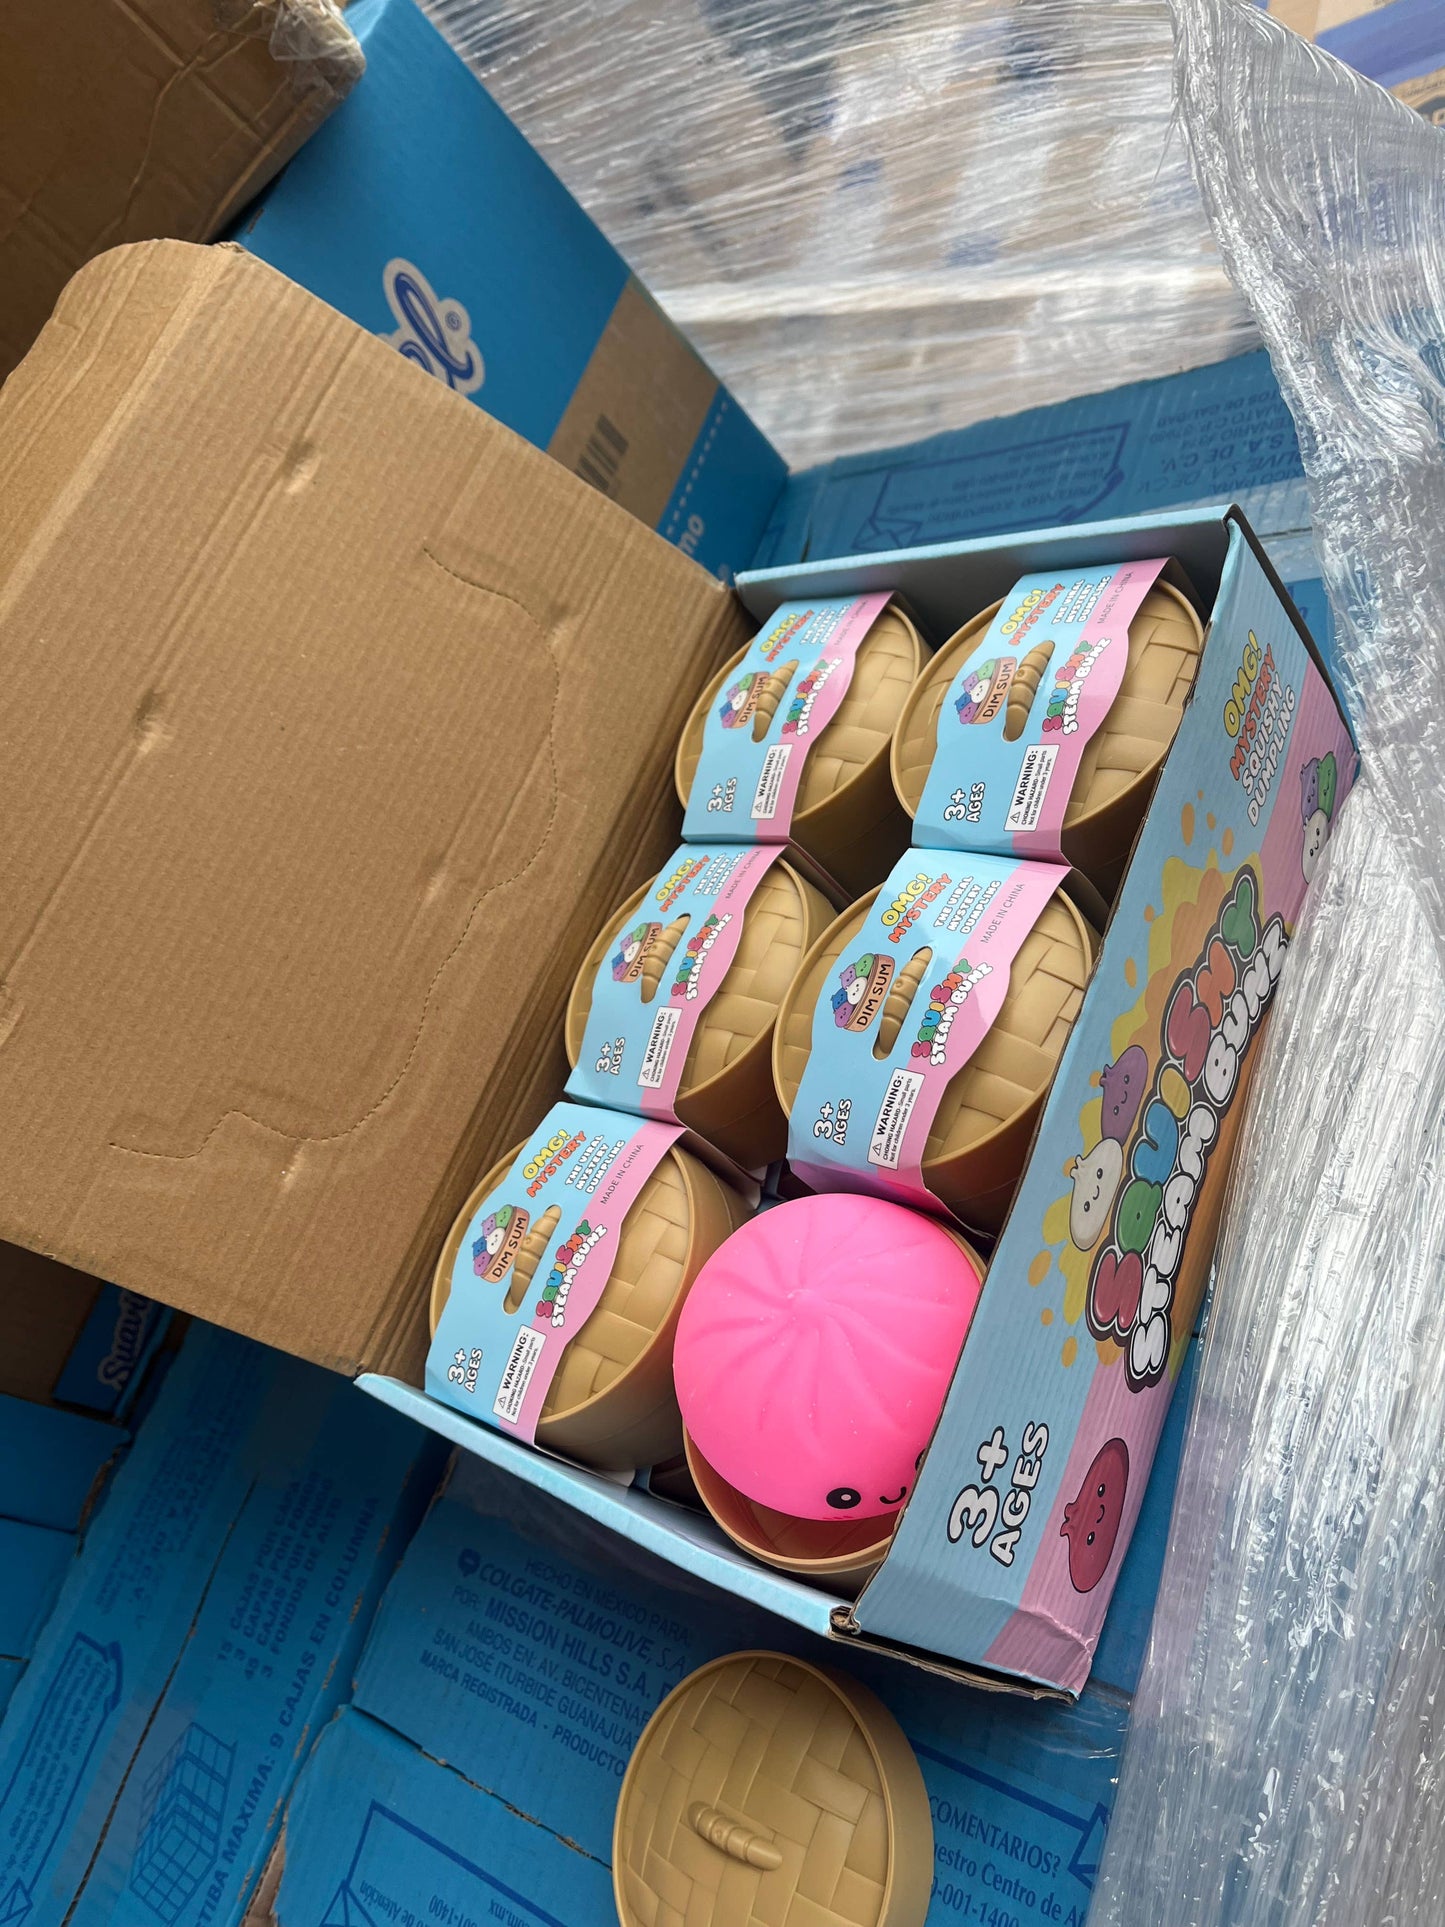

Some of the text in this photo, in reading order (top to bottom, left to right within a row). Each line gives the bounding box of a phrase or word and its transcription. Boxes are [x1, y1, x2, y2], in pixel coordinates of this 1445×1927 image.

[1204, 445, 1235, 463] DE
[1000, 588, 1048, 634] OMG!
[1008, 584, 1065, 646] MYSTERY
[1051, 579, 1086, 624] THE VIRAL
[1064, 583, 1094, 623] MYSTERY
[1077, 576, 1111, 622] DUMPLING
[1097, 602, 1115, 624] MADE
[760, 614, 799, 652] OMG!
[766, 609, 814, 662] MYSTERY
[983, 662, 1014, 718] DIM SUM
[1042, 640, 1093, 732] SQUISHY
[1063, 637, 1112, 735] STEAM BUNZ
[1223, 629, 1262, 738] OMG!
[740, 704, 754, 722] DIM
[796, 692, 818, 736] STEAM
[1230, 643, 1275, 780] MYSTERY
[1242, 671, 1284, 795] SQUISHY
[758, 749, 778, 797] WARNING:
[1015, 750, 1038, 806] WARNING:
[1246, 684, 1296, 827] DUMPLING
[707, 784, 724, 813] 3+
[722, 777, 737, 813] AGES
[944, 788, 966, 821] 3+
[967, 782, 985, 823] AGES
[656, 858, 697, 901] OMG!
[659, 855, 710, 912] MYSTERY
[702, 858, 730, 895] MYSTERY
[882, 873, 933, 926] OMG!
[933, 876, 974, 928] THE VIRAL
[888, 873, 952, 943] MYSTERY
[947, 884, 982, 931] MYSTERY
[960, 880, 1001, 934] DUMPLING
[980, 884, 1025, 944] MADE IN CHINA
[630, 927, 659, 977] DIM SUM
[685, 913, 733, 1000] STEAM BUNZ
[857, 963, 892, 1026] DIM SUM
[911, 958, 972, 1058] SQUISHY
[930, 962, 993, 1066] STEAM BUNZ
[596, 1042, 612, 1073] 3+
[610, 1037, 625, 1075] AGES
[646, 1012, 666, 1062] WARNING:
[814, 1102, 834, 1138] 3+
[833, 1099, 851, 1145] AGES
[877, 1076, 904, 1135] WARNING:
[1092, 877, 1258, 1331] SQUISHY
[523, 1129, 571, 1179] OMG!
[883, 1133, 893, 1160] CHOKING
[894, 1121, 903, 1143] children
[1130, 915, 1290, 1376] STEAM BUNZ
[526, 1131, 586, 1197] MYSTERY
[565, 1135, 604, 1185] THE VIRAL
[575, 1143, 609, 1190] MYSTERY
[585, 1140, 625, 1194] DUMPLING
[600, 1144, 644, 1205] MADE IN CHINA
[492, 1217, 527, 1278] DIM SUM
[536, 1219, 592, 1318] SQUISHY
[551, 1224, 608, 1328] STEAM BUNZ
[448, 1348, 466, 1385] 3+
[464, 1348, 482, 1393] AGES
[503, 1332, 529, 1389] WARNING:
[506, 1388, 517, 1414] CHOKING
[947, 1426, 1009, 1548] 3+
[990, 1420, 1050, 1568] AGES
[525, 1557, 572, 1590] HECHO
[572, 1577, 590, 1598] EN
[433, 1628, 460, 1653] SAN
[460, 1641, 496, 1675] JOSÉ
[494, 1663, 557, 1707] ITURBIDE
[452, 1584, 658, 1698] POR: MISSION HILLS S.A.
[222, 1755, 275, 1865] MAXIMA:
[269, 1732, 286, 1750] 9
[280, 1653, 317, 1727] CAJAS
[310, 1612, 332, 1646] EN
[325, 1497, 378, 1608] COLUMNA
[418, 1650, 460, 1683] MARCA
[460, 1672, 540, 1728] REGISTRADA
[466, 1620, 651, 1730] AMBOS EN: AV. BICENTENAR
[982, 1862, 1036, 1908] Centro
[1041, 1892, 1062, 1922] de
